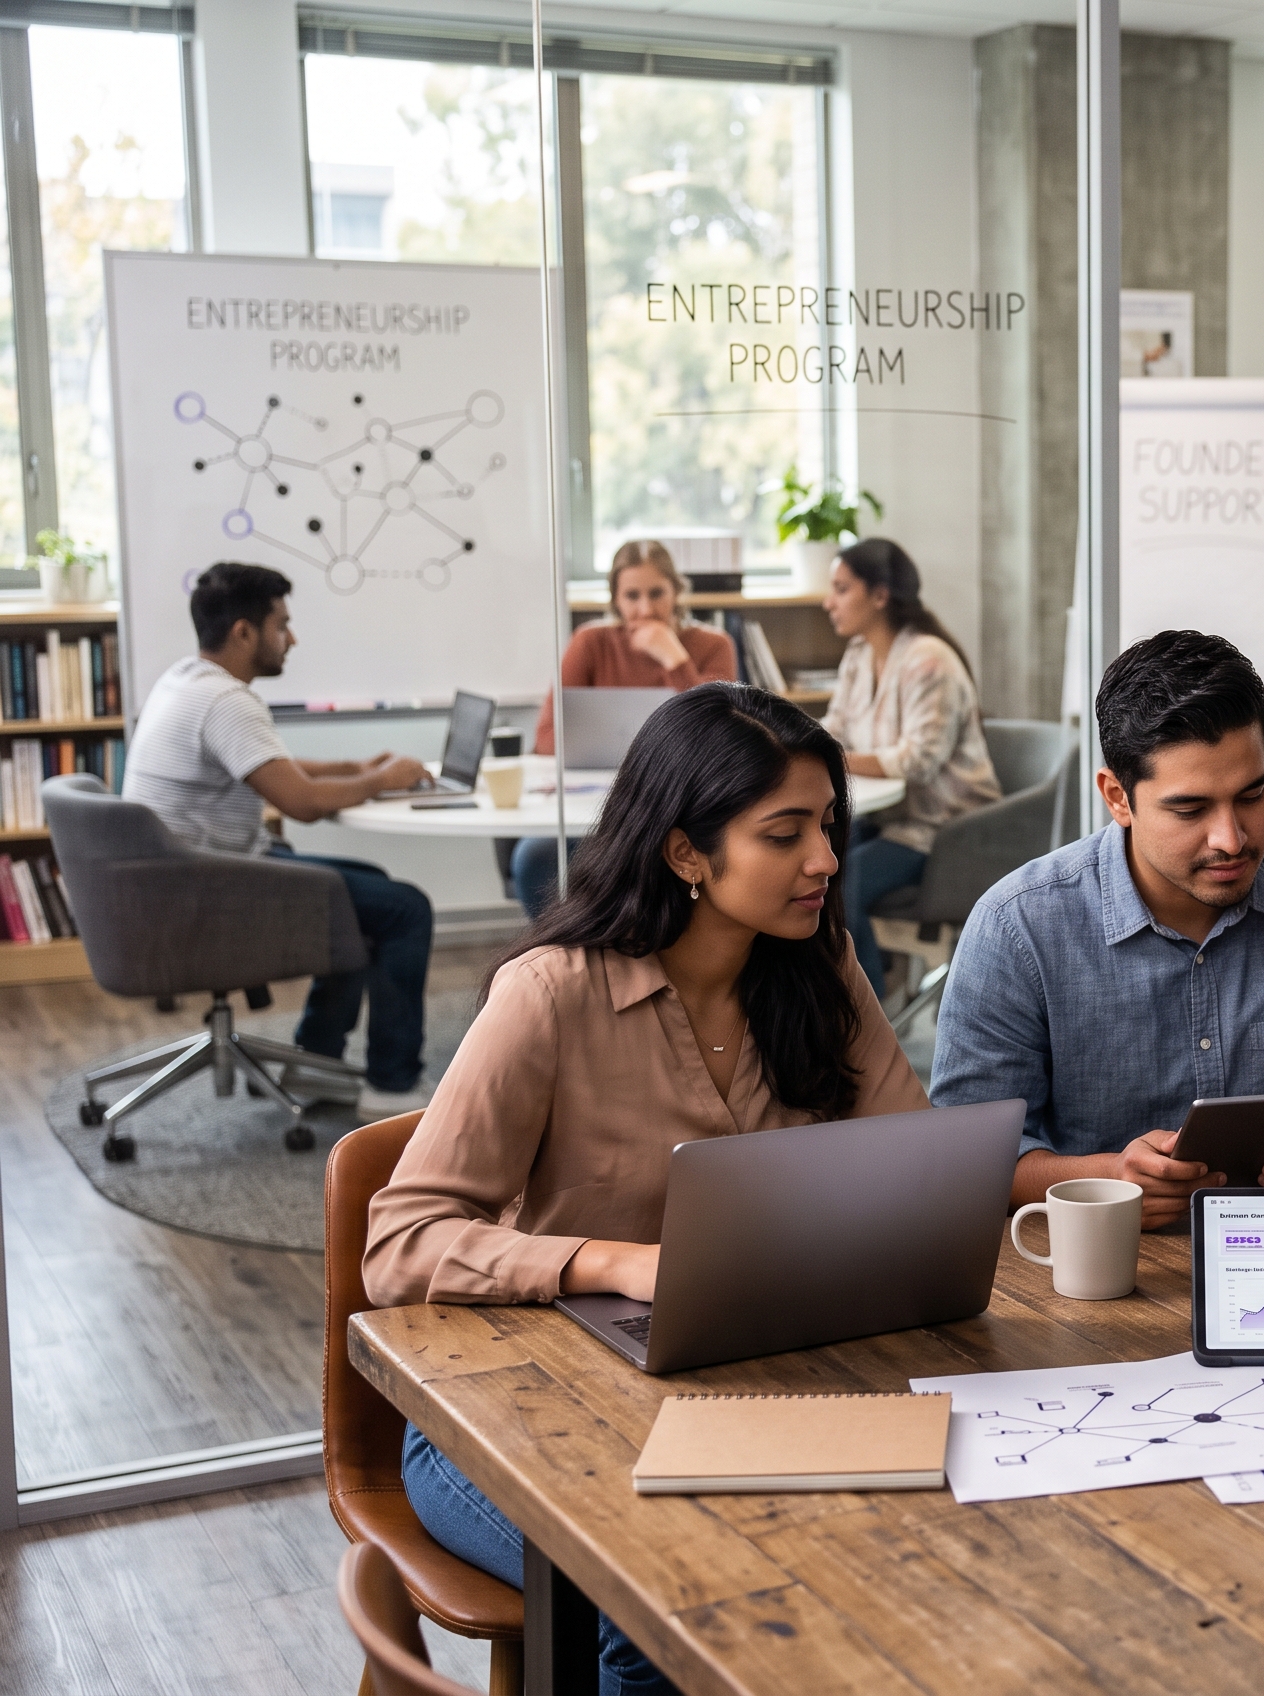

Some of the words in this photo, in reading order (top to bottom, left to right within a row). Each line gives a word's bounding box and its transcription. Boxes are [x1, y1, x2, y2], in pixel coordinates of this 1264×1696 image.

[185, 297, 471, 336] ENTREPRENEURSHIP
[647, 282, 1026, 331] ENTREPRENEURSHIP
[269, 339, 402, 372] PROGRAM
[729, 342, 906, 386] PROGRAM
